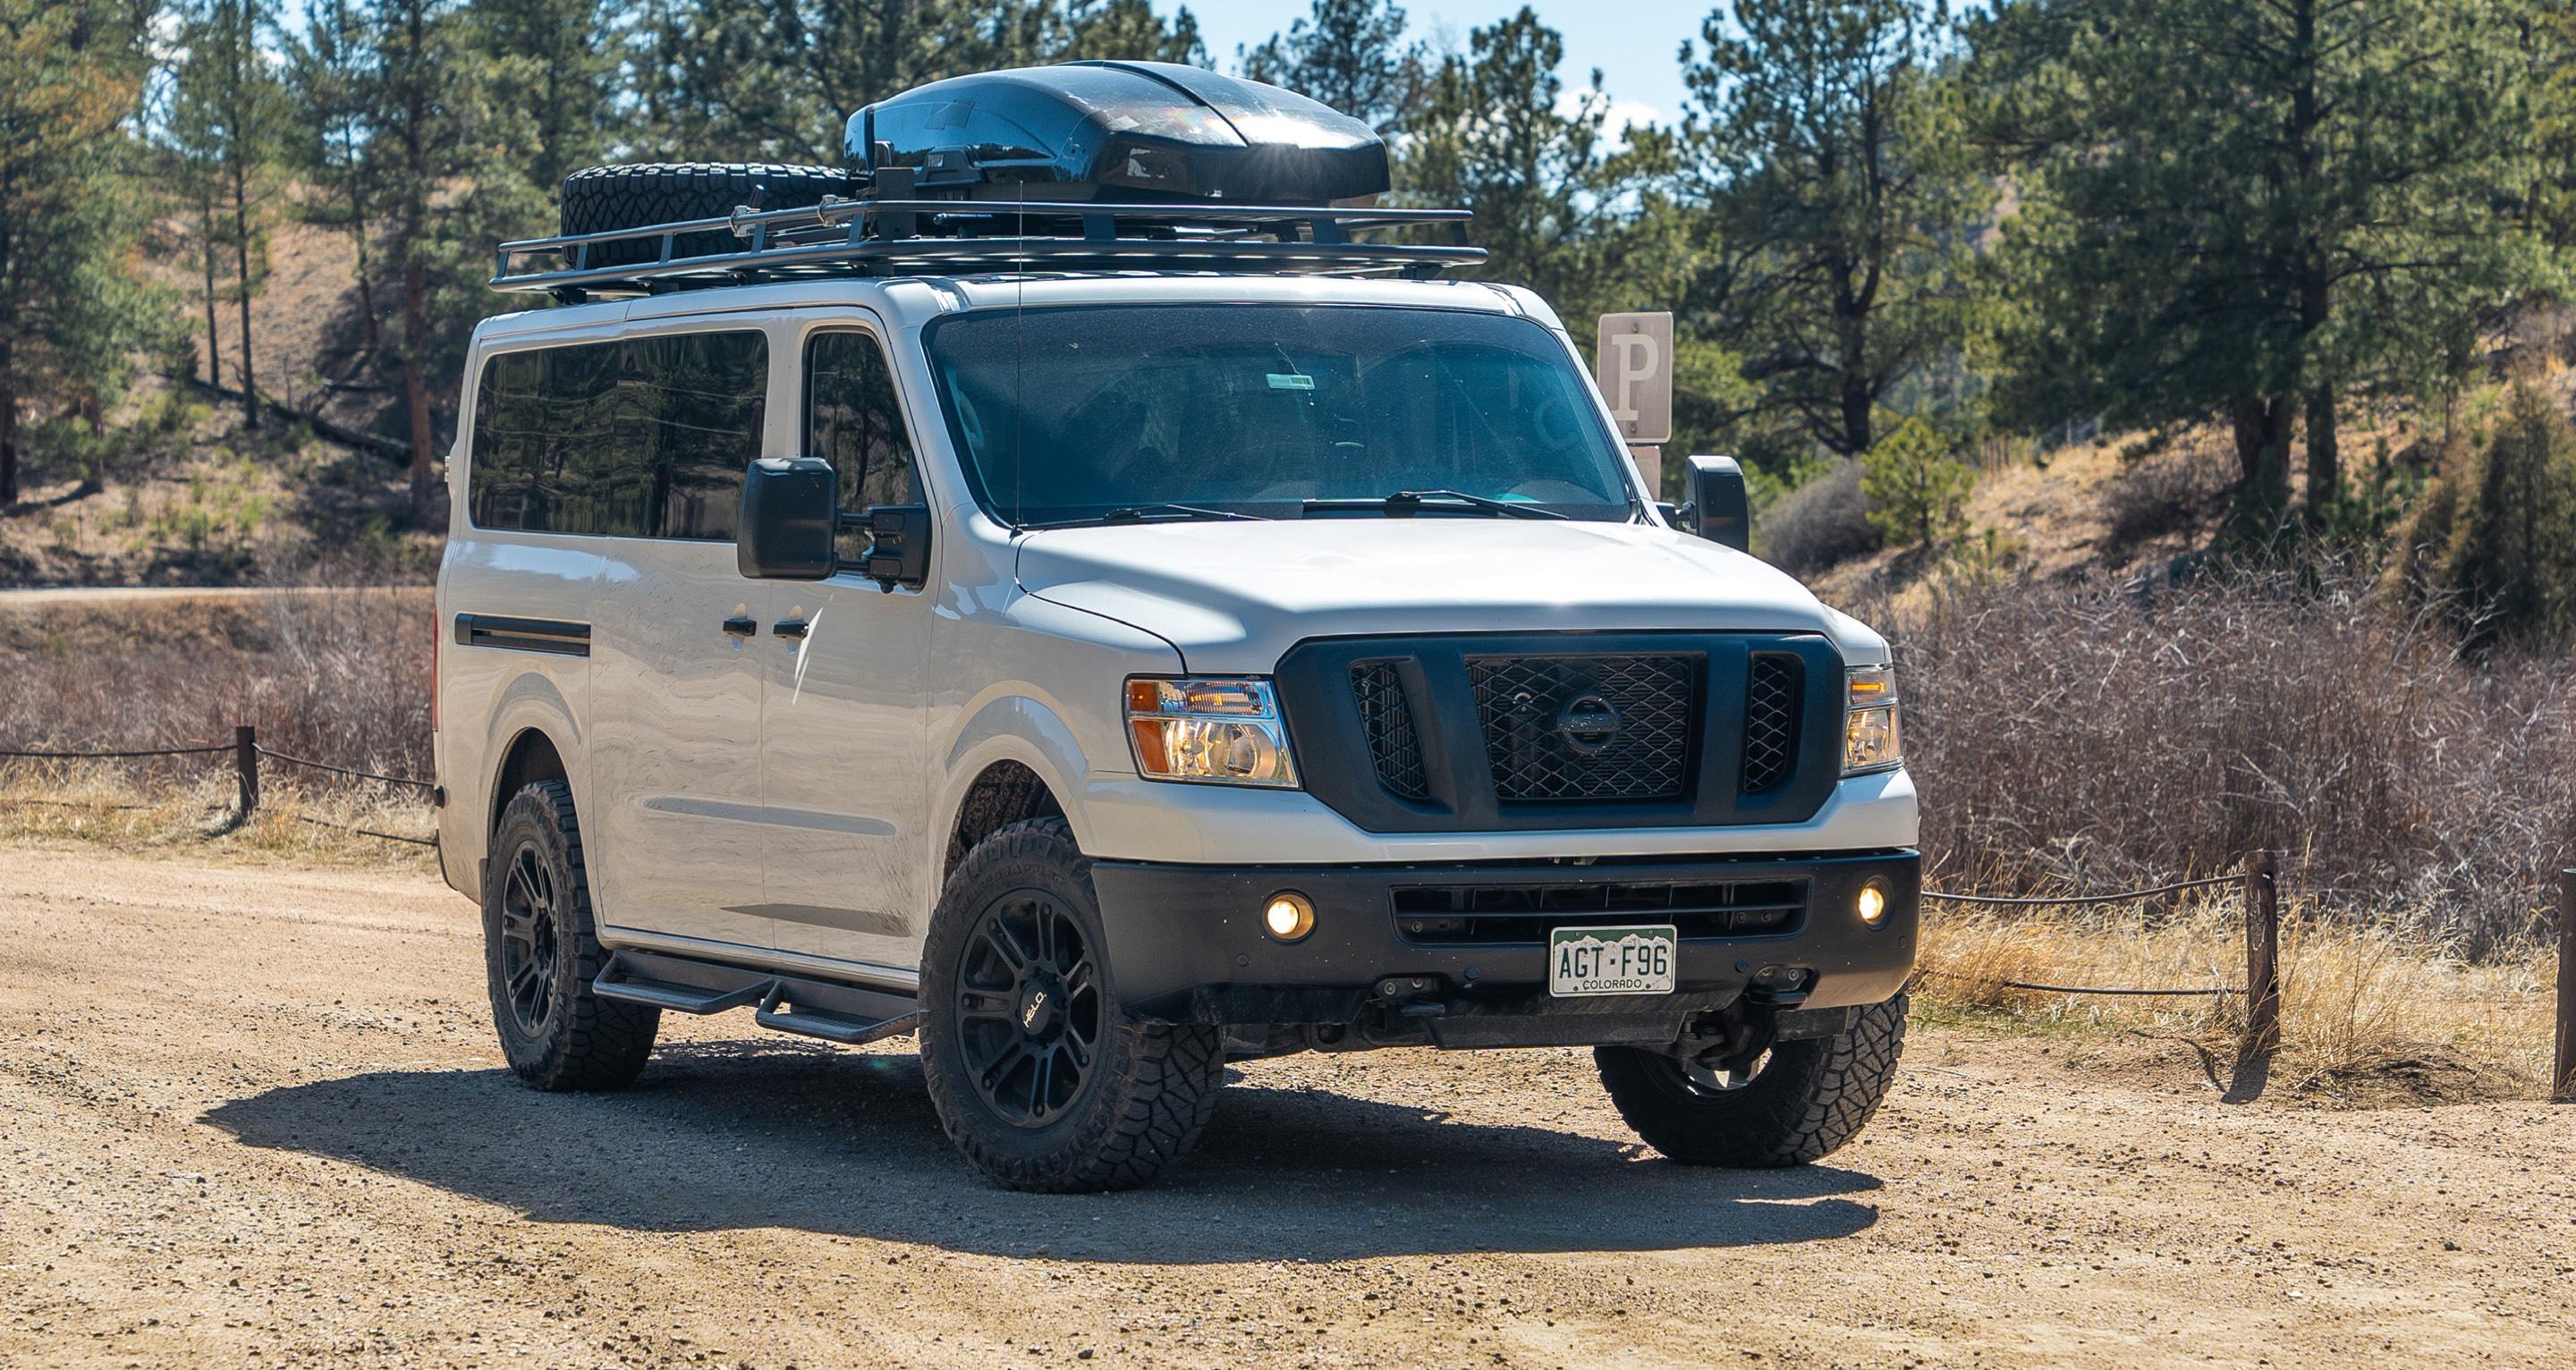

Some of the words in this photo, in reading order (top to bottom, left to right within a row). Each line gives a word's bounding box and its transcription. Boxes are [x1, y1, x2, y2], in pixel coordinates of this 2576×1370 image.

[1611, 334, 1659, 421] P
[1582, 979, 1643, 990] COLORADO
[1023, 991, 1045, 1028] HELO
